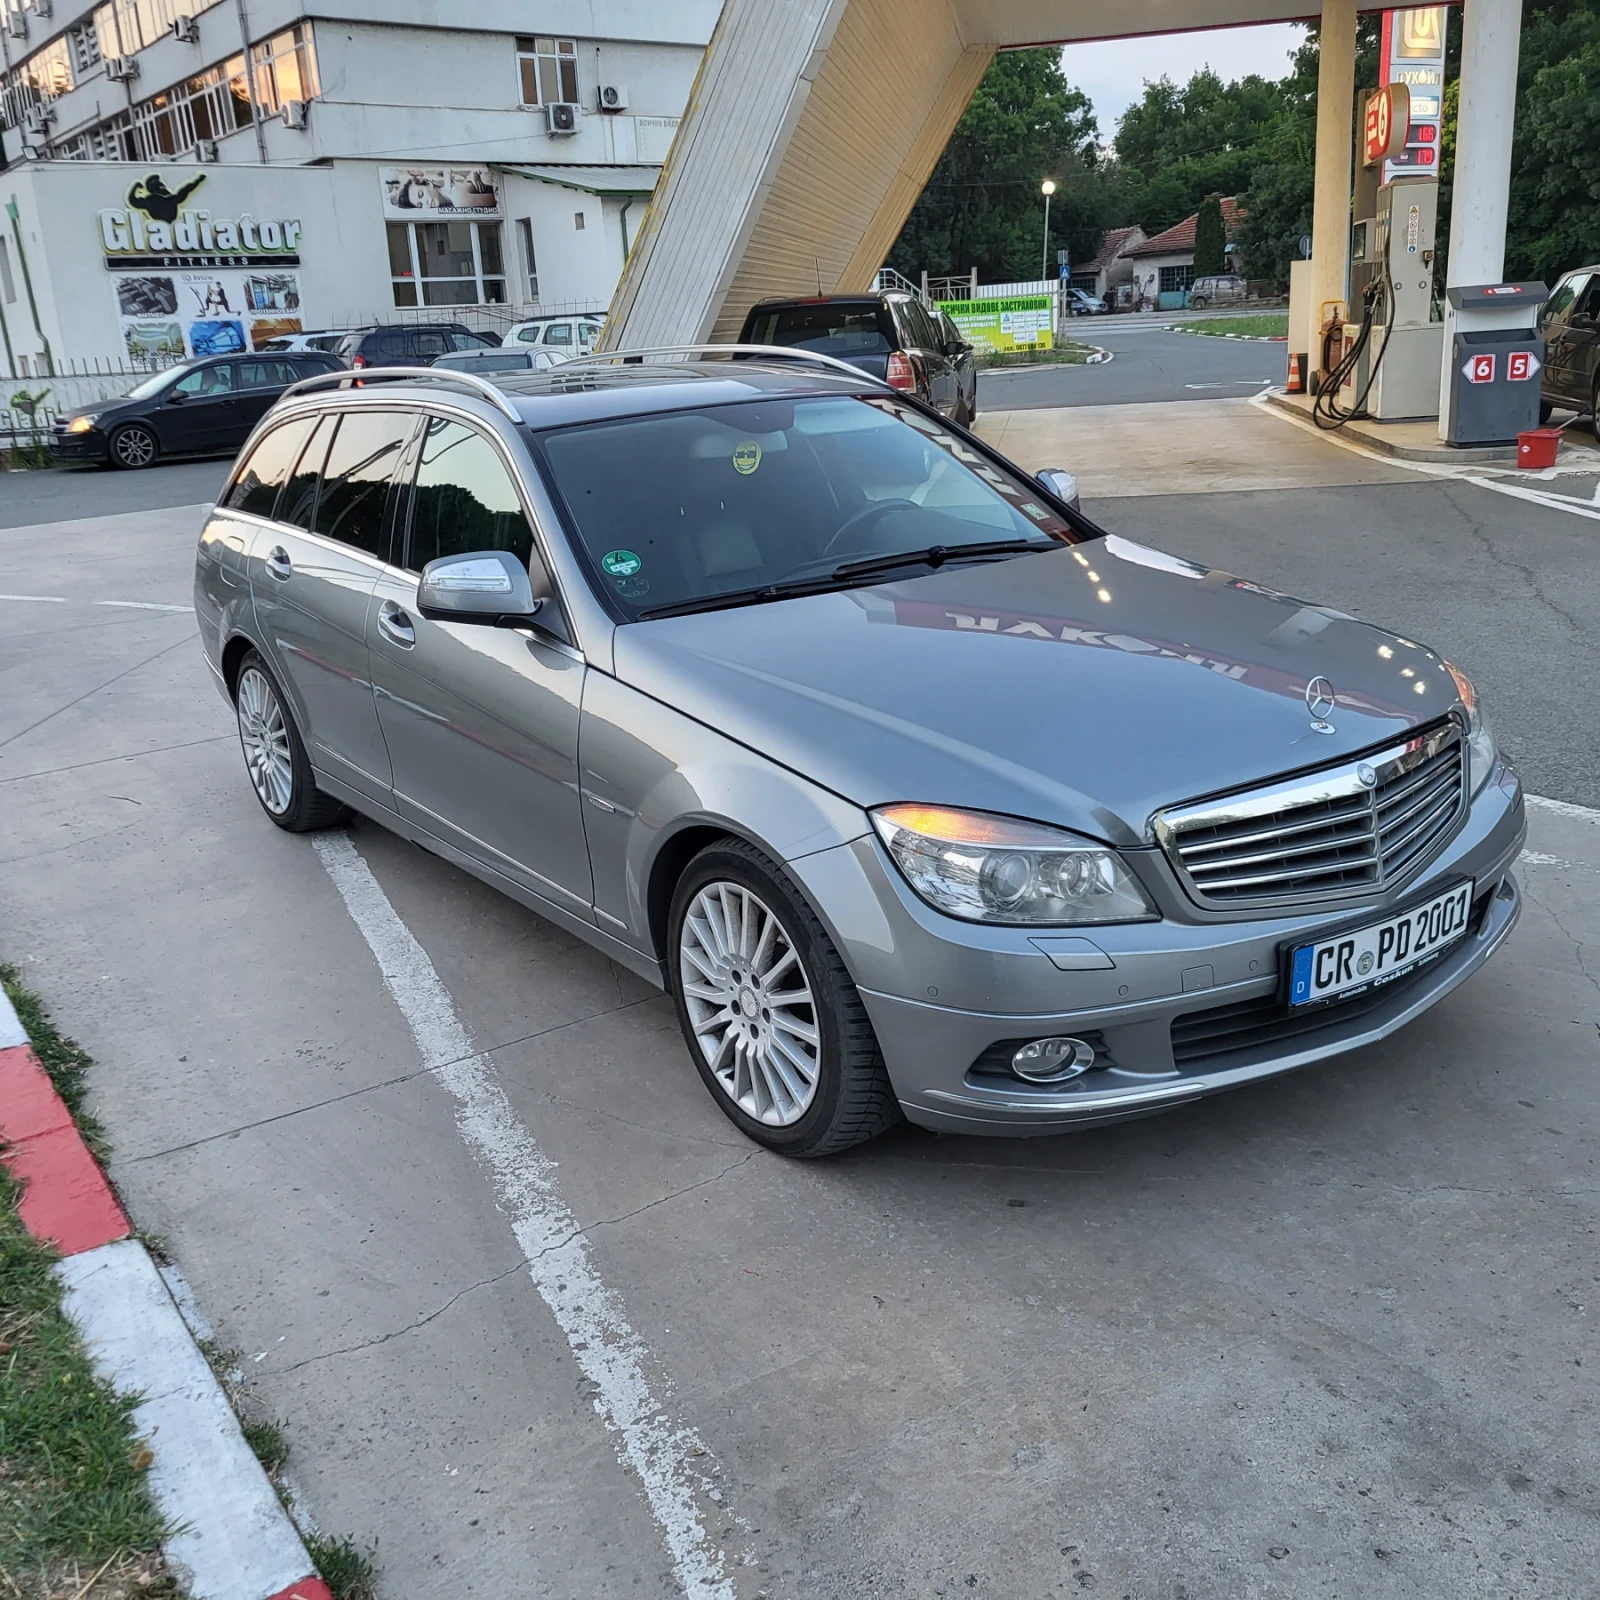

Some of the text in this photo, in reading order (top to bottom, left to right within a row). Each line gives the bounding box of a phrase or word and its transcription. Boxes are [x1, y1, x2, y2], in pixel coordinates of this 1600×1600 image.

[1411, 103, 1429, 113] cto
[100, 209, 302, 252] Gladiator
[163, 257, 250, 267] FITNESS
[940, 299, 1047, 315] ВСИЧКИ ВИДОВЕ ЗАСТРАХОВКИ
[1477, 361, 1490, 377] 6
[1513, 359, 1526, 375] 5
[614, 551, 625, 562] 4
[1315, 889, 1468, 990] CR PD 2001
[1296, 981, 1305, 994] D
